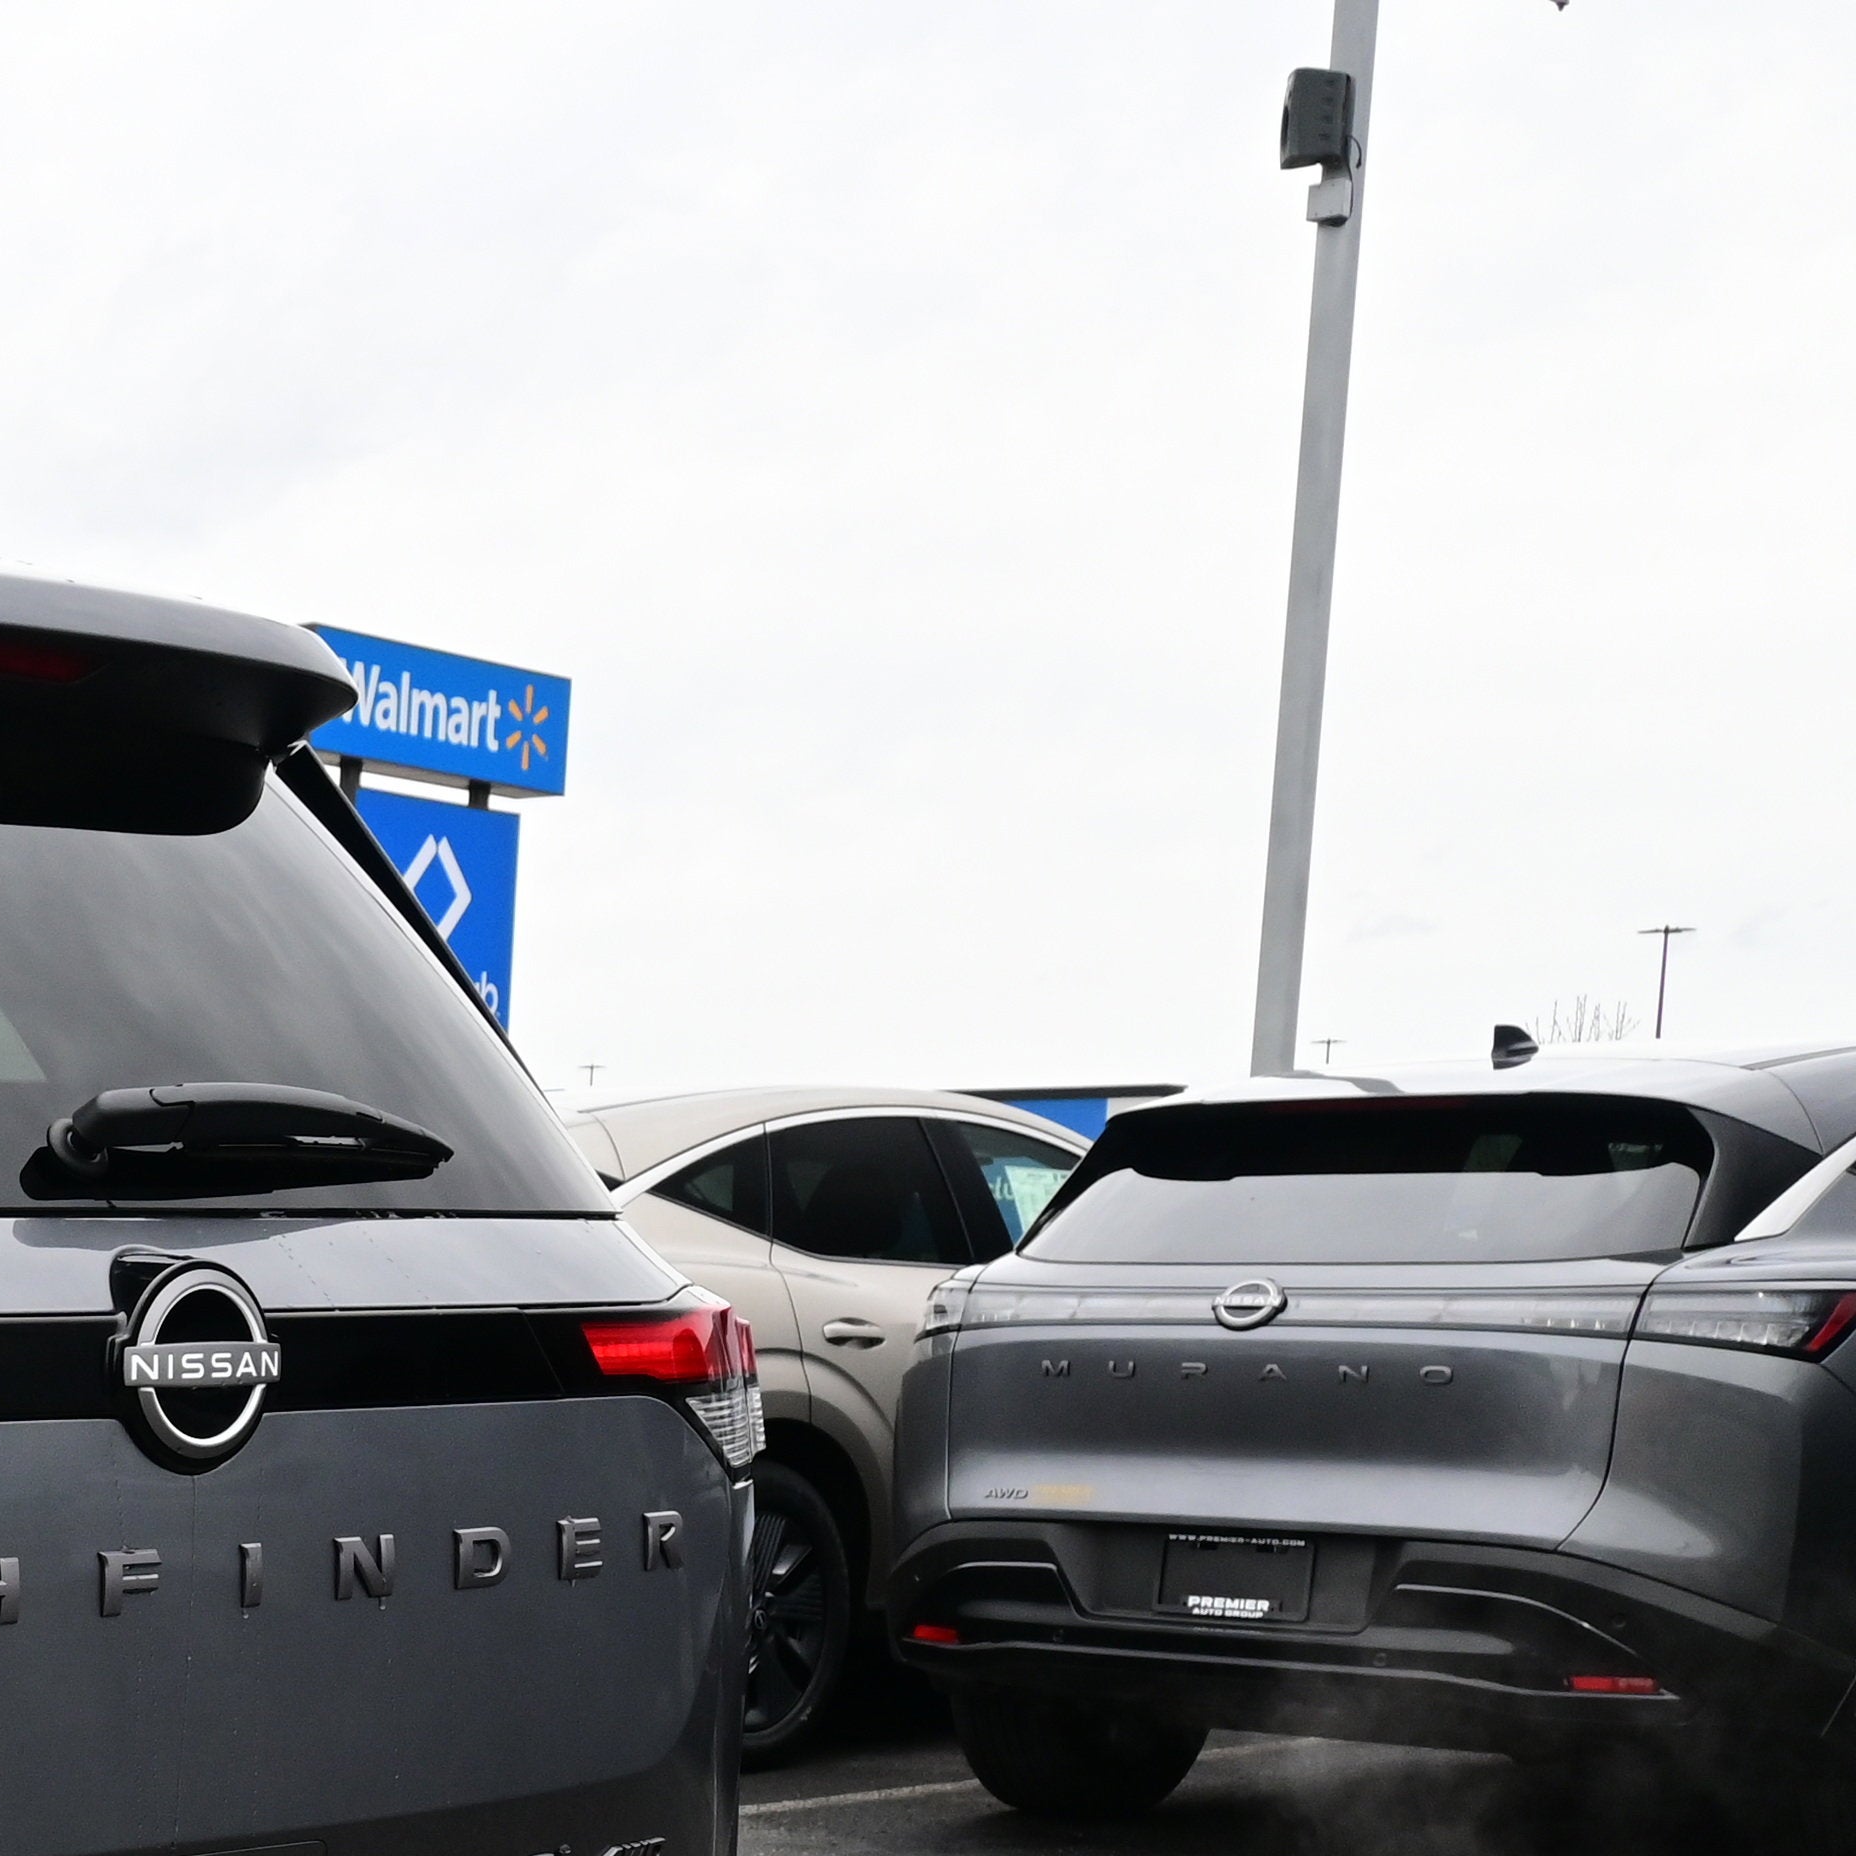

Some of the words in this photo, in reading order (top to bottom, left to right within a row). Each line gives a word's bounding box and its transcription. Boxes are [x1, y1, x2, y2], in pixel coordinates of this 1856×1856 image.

[338, 657, 502, 752] Walmart
[131, 1351, 279, 1380] NISSAN
[1040, 1358, 1454, 1385] MURANO
[984, 1487, 1029, 1500] AWD
[1187, 1595, 1271, 1612] PREMIER
[1191, 1606, 1223, 1617] AUTO
[1224, 1608, 1265, 1619] GROUP
